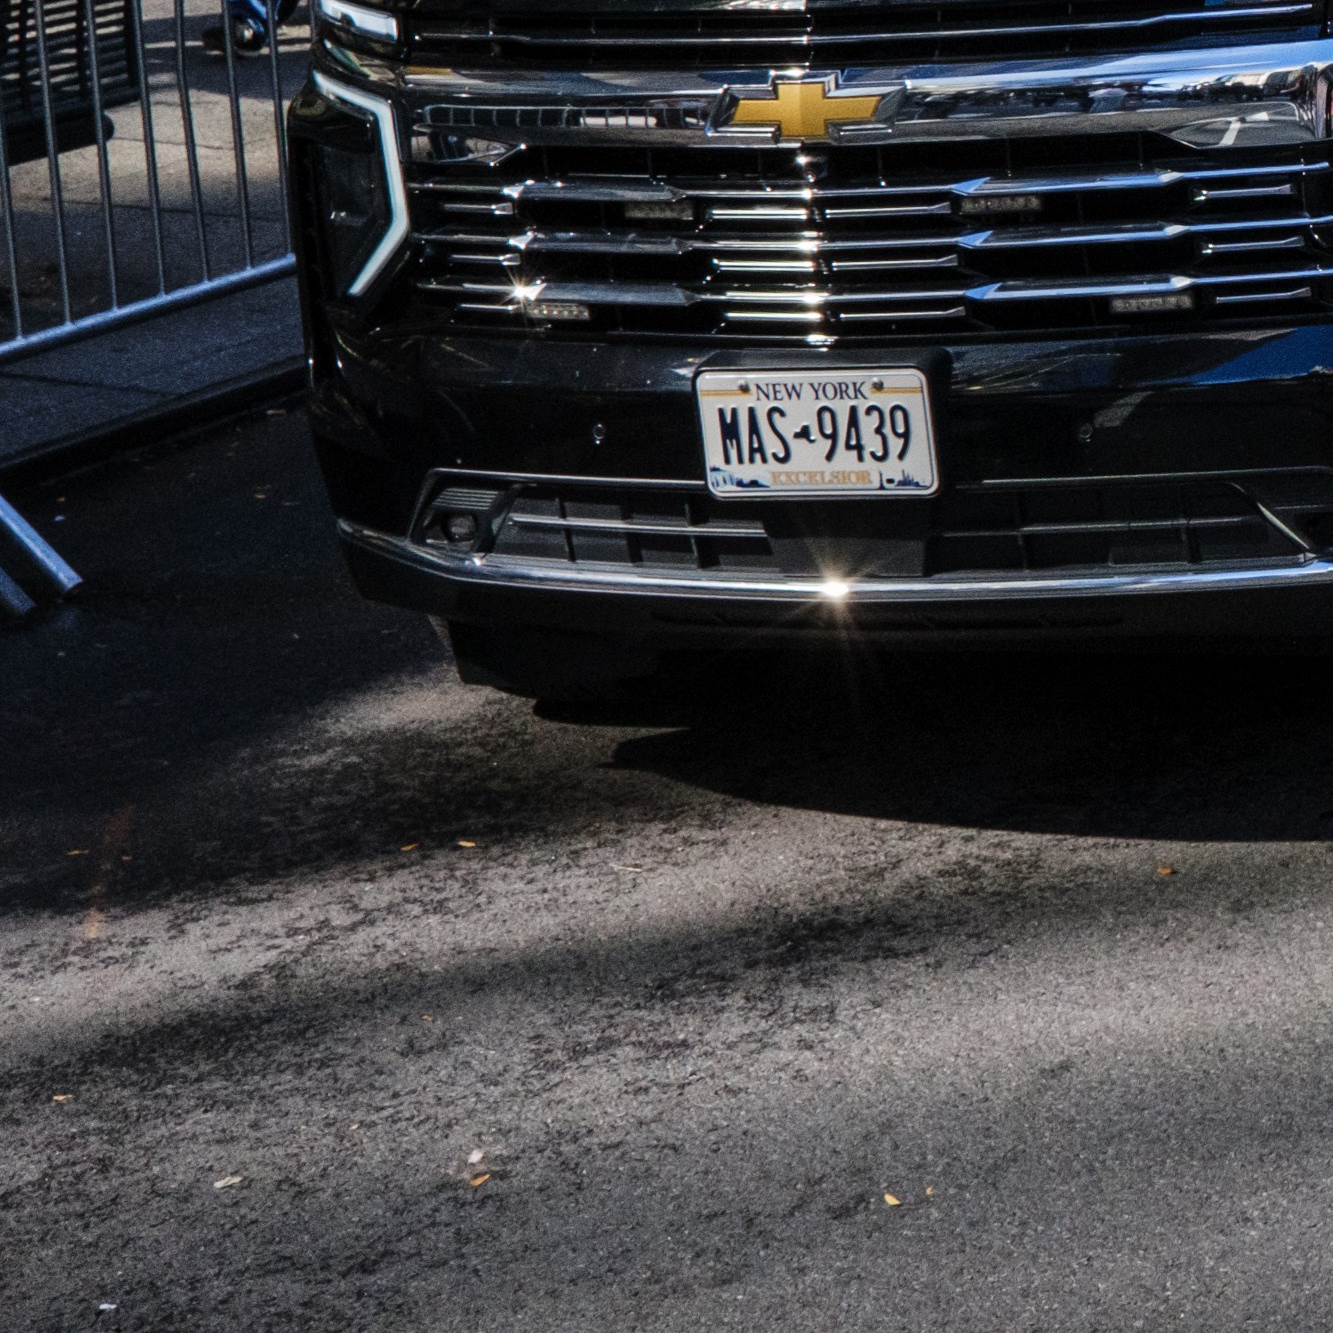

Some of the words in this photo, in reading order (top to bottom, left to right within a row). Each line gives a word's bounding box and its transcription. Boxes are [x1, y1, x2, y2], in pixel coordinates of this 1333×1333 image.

[756, 383, 803, 401] NEW
[808, 381, 868, 400] YORK
[769, 469, 872, 486] EXCELSIOR
